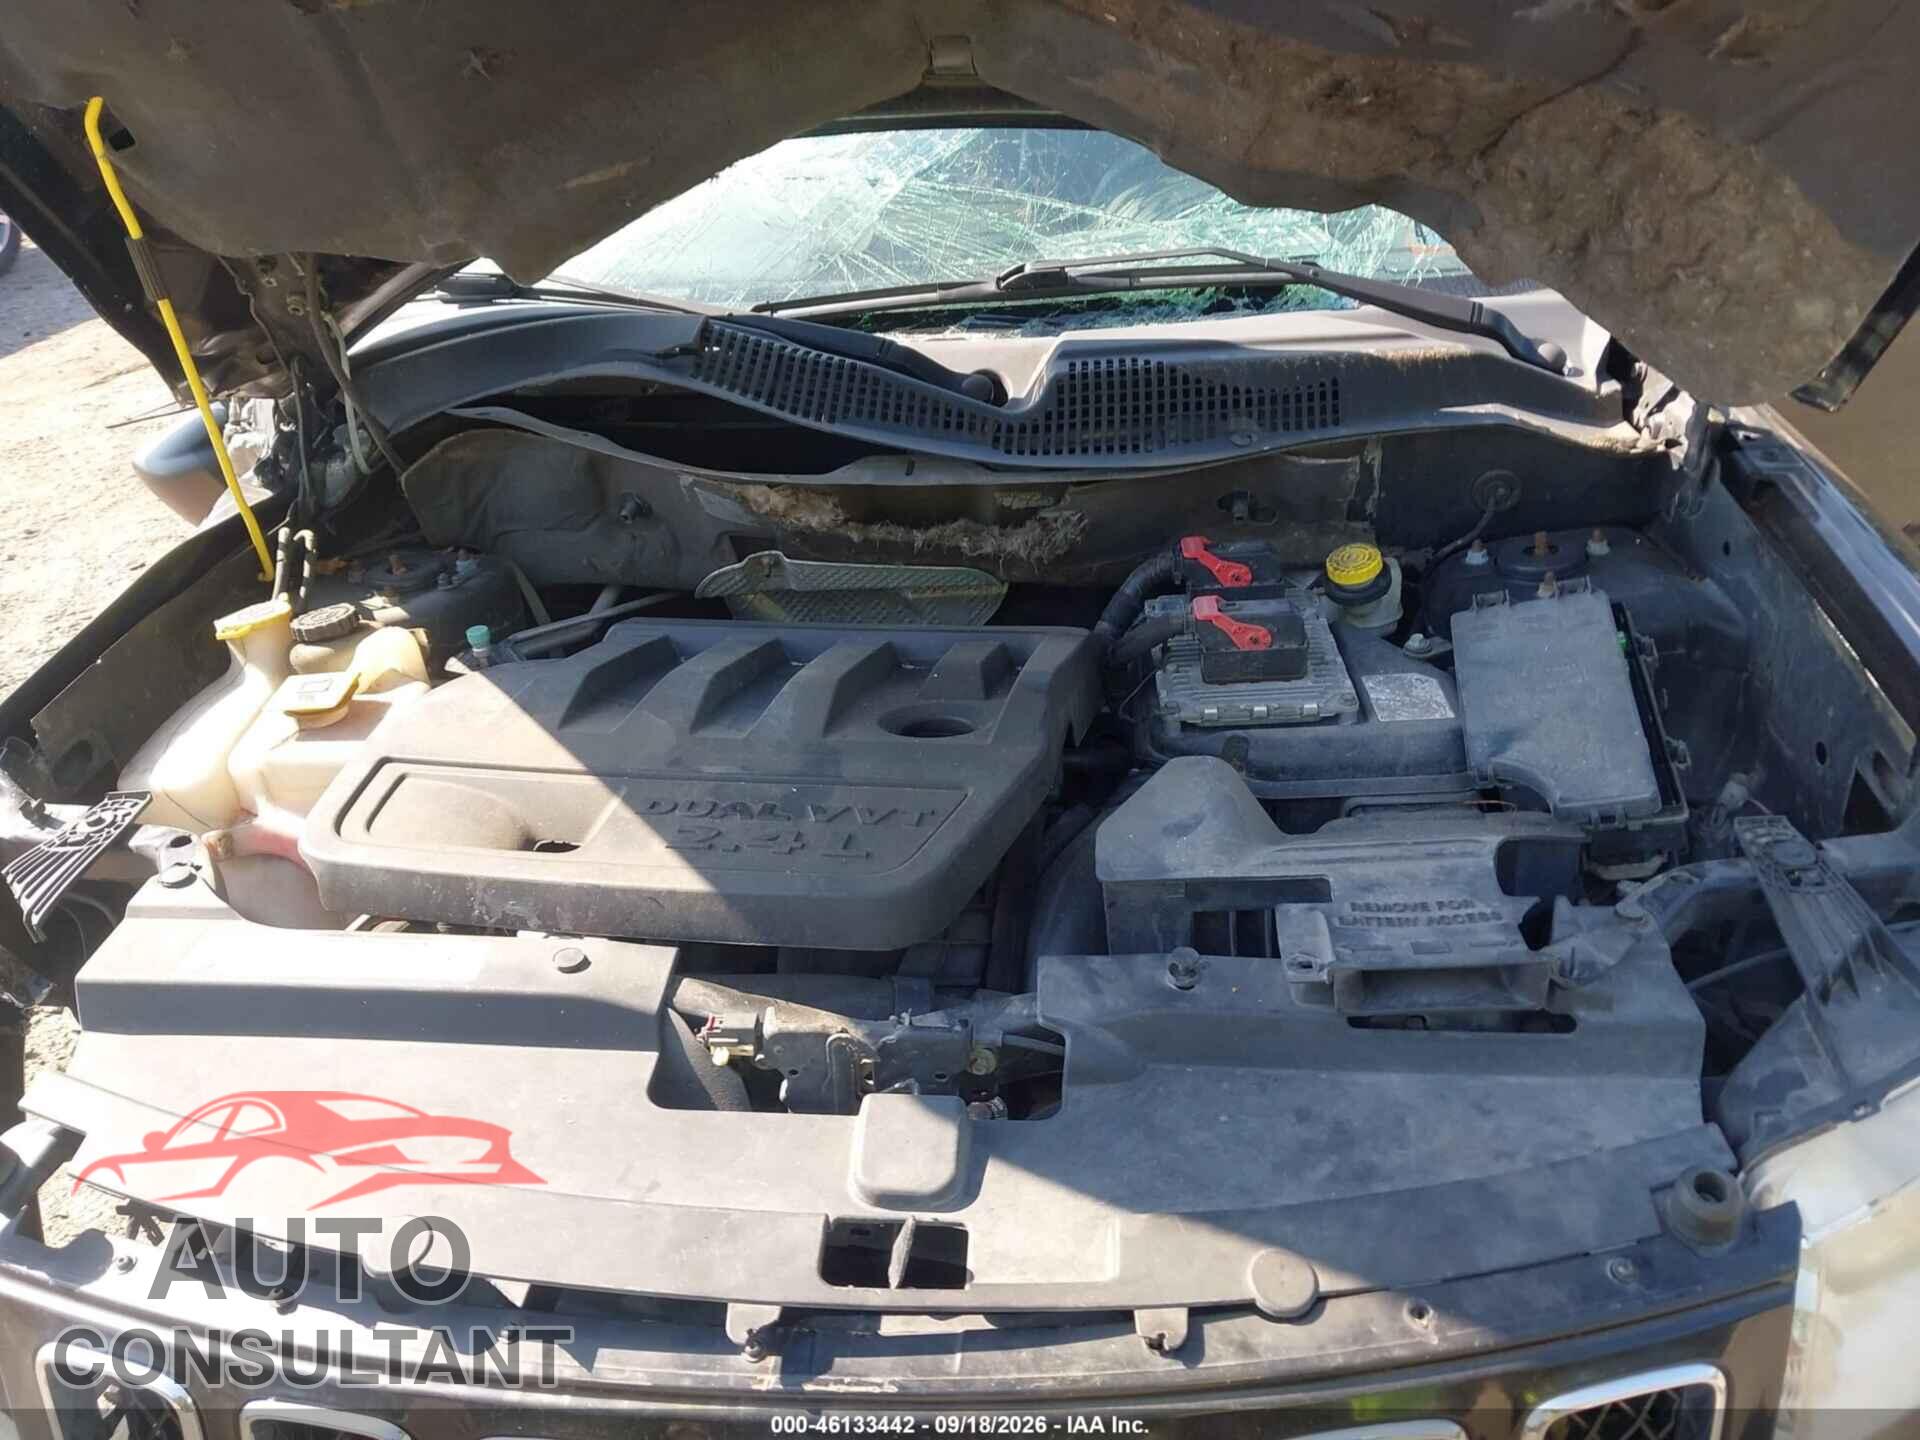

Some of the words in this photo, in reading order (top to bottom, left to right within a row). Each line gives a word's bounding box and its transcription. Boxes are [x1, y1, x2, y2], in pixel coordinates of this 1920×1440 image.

[638, 800, 792, 823] DUAL
[806, 804, 937, 828] VVT
[1350, 901, 1431, 913] REMOVE
[1436, 899, 1476, 911] FOR
[1427, 911, 1503, 927] ACCESS
